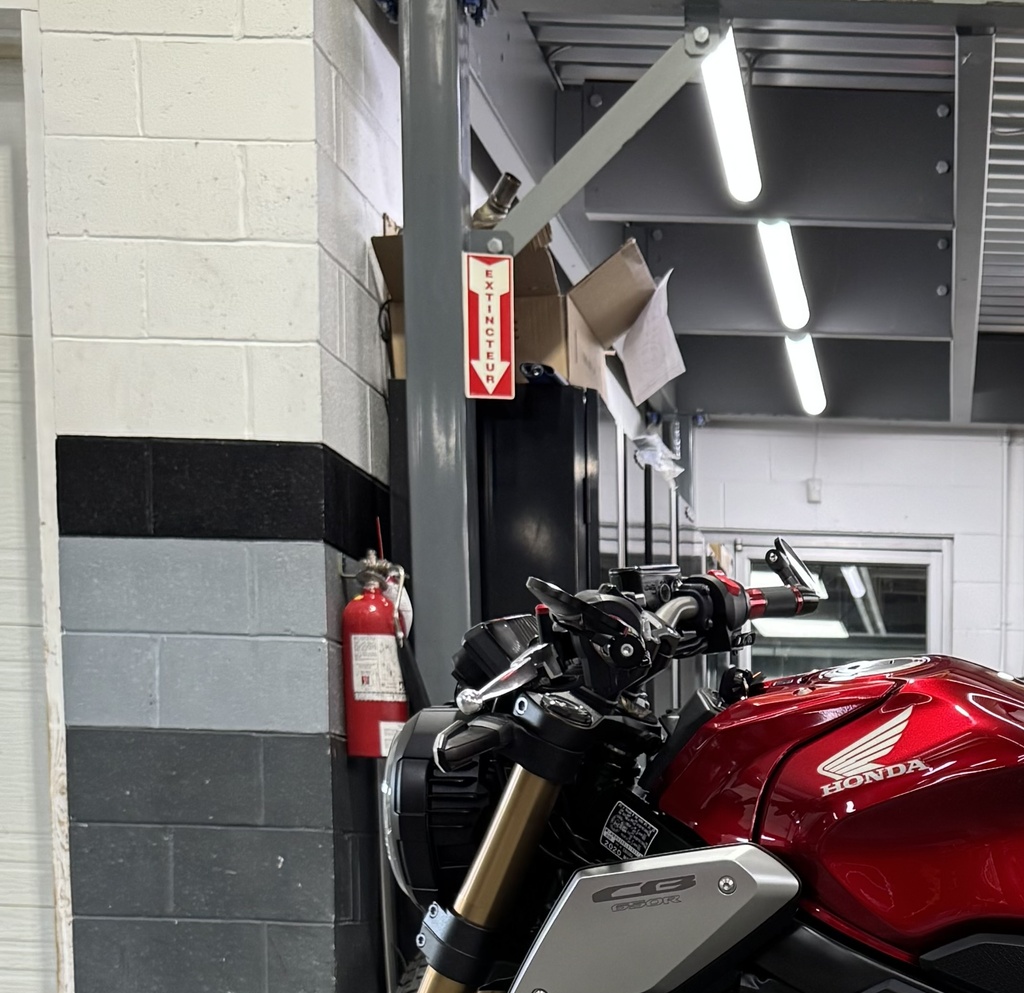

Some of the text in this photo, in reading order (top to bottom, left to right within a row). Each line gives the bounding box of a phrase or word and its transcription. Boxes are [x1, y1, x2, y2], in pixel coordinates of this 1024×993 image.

[485, 269, 495, 383] EXTINCTEUR
[820, 759, 931, 797] HONDA
[604, 840, 622, 856] 2020
[592, 875, 696, 903] CB
[611, 895, 682, 912] 650R
